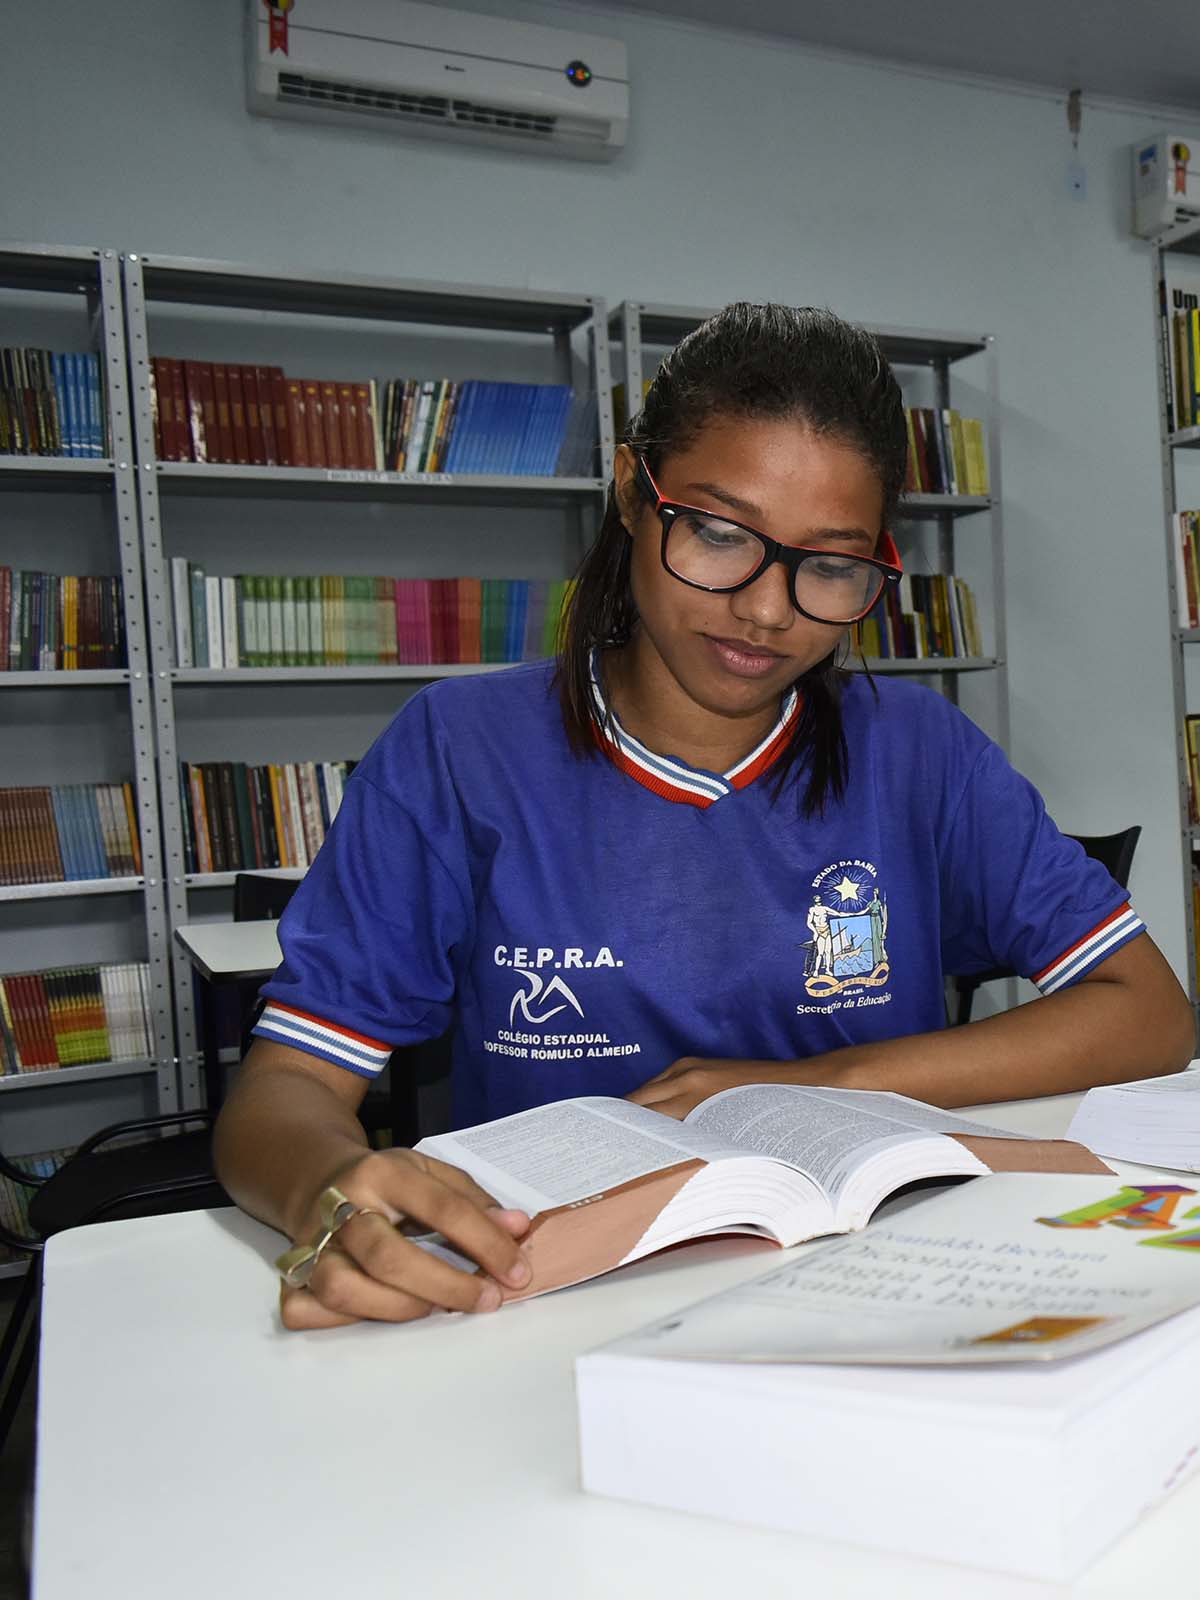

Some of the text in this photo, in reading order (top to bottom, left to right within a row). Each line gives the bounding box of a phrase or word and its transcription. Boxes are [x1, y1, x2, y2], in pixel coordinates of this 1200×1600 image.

[1173, 288, 1197, 309] Um
[812, 863, 838, 888] ESTADO
[854, 860, 877, 878] BAHIA
[494, 945, 623, 968] C.E.P.R.A.
[843, 988, 864, 996] BRASIL
[843, 999, 855, 1008] da
[498, 1030, 610, 1045] COLÉGIO ESTADUAL
[587, 1043, 641, 1058] ALMEIDA
